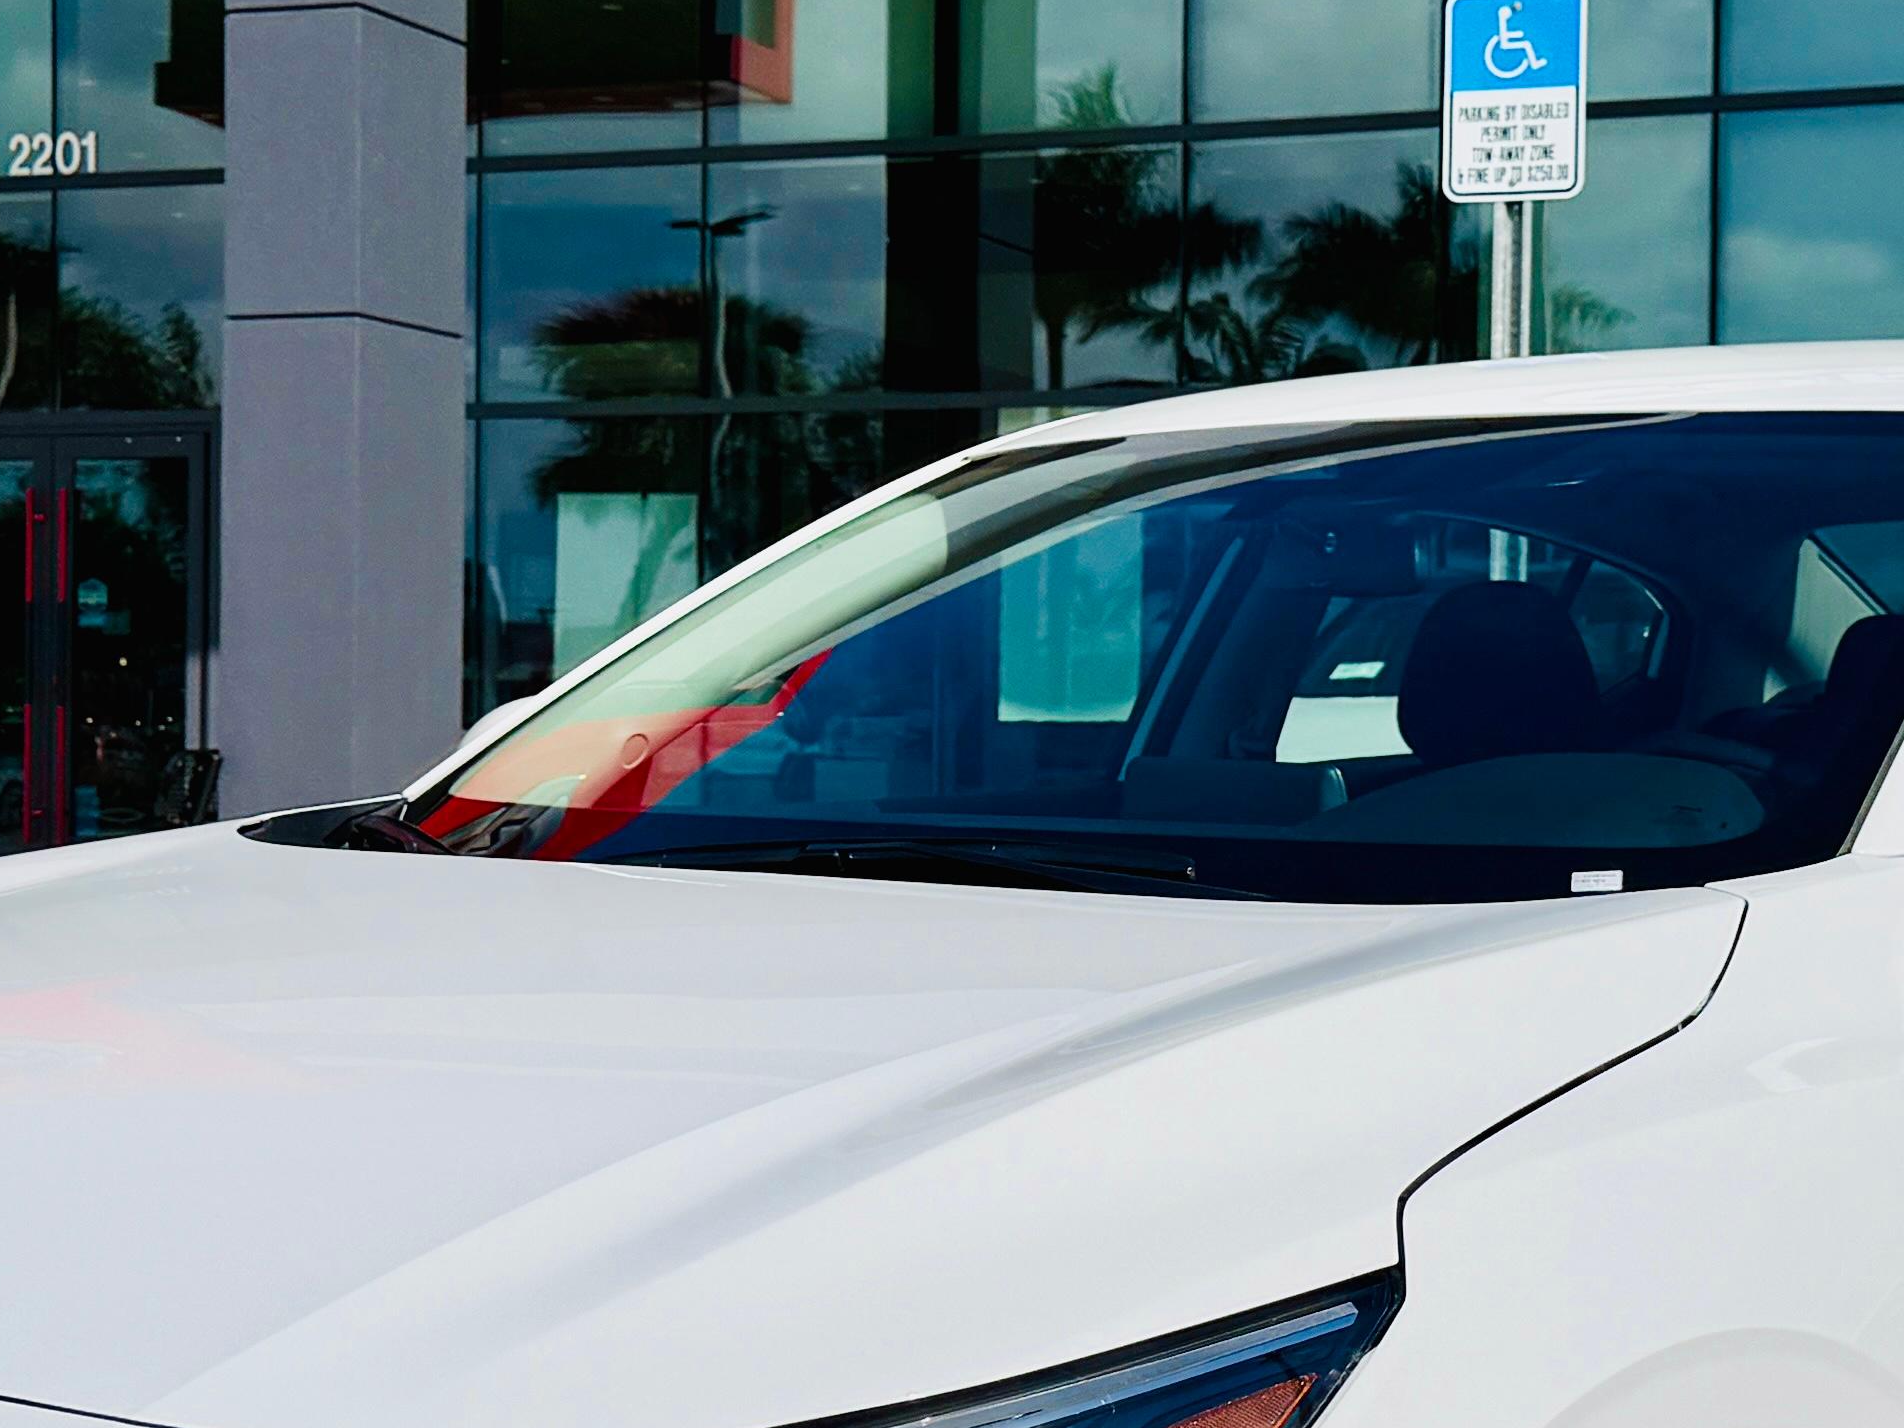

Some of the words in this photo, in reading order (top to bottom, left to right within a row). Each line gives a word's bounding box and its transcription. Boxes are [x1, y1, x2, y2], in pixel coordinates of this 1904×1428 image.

[1458, 105, 1500, 123] PARKING
[1505, 104, 1516, 122] BY
[1521, 101, 1570, 120] DISABLED
[1480, 125, 1518, 142] PERMIT
[1522, 124, 1546, 141] ONLY
[8, 130, 98, 177] 2201
[1530, 144, 1556, 161] ZONE
[1468, 167, 1489, 184] FINE
[1494, 167, 1507, 183] UP
